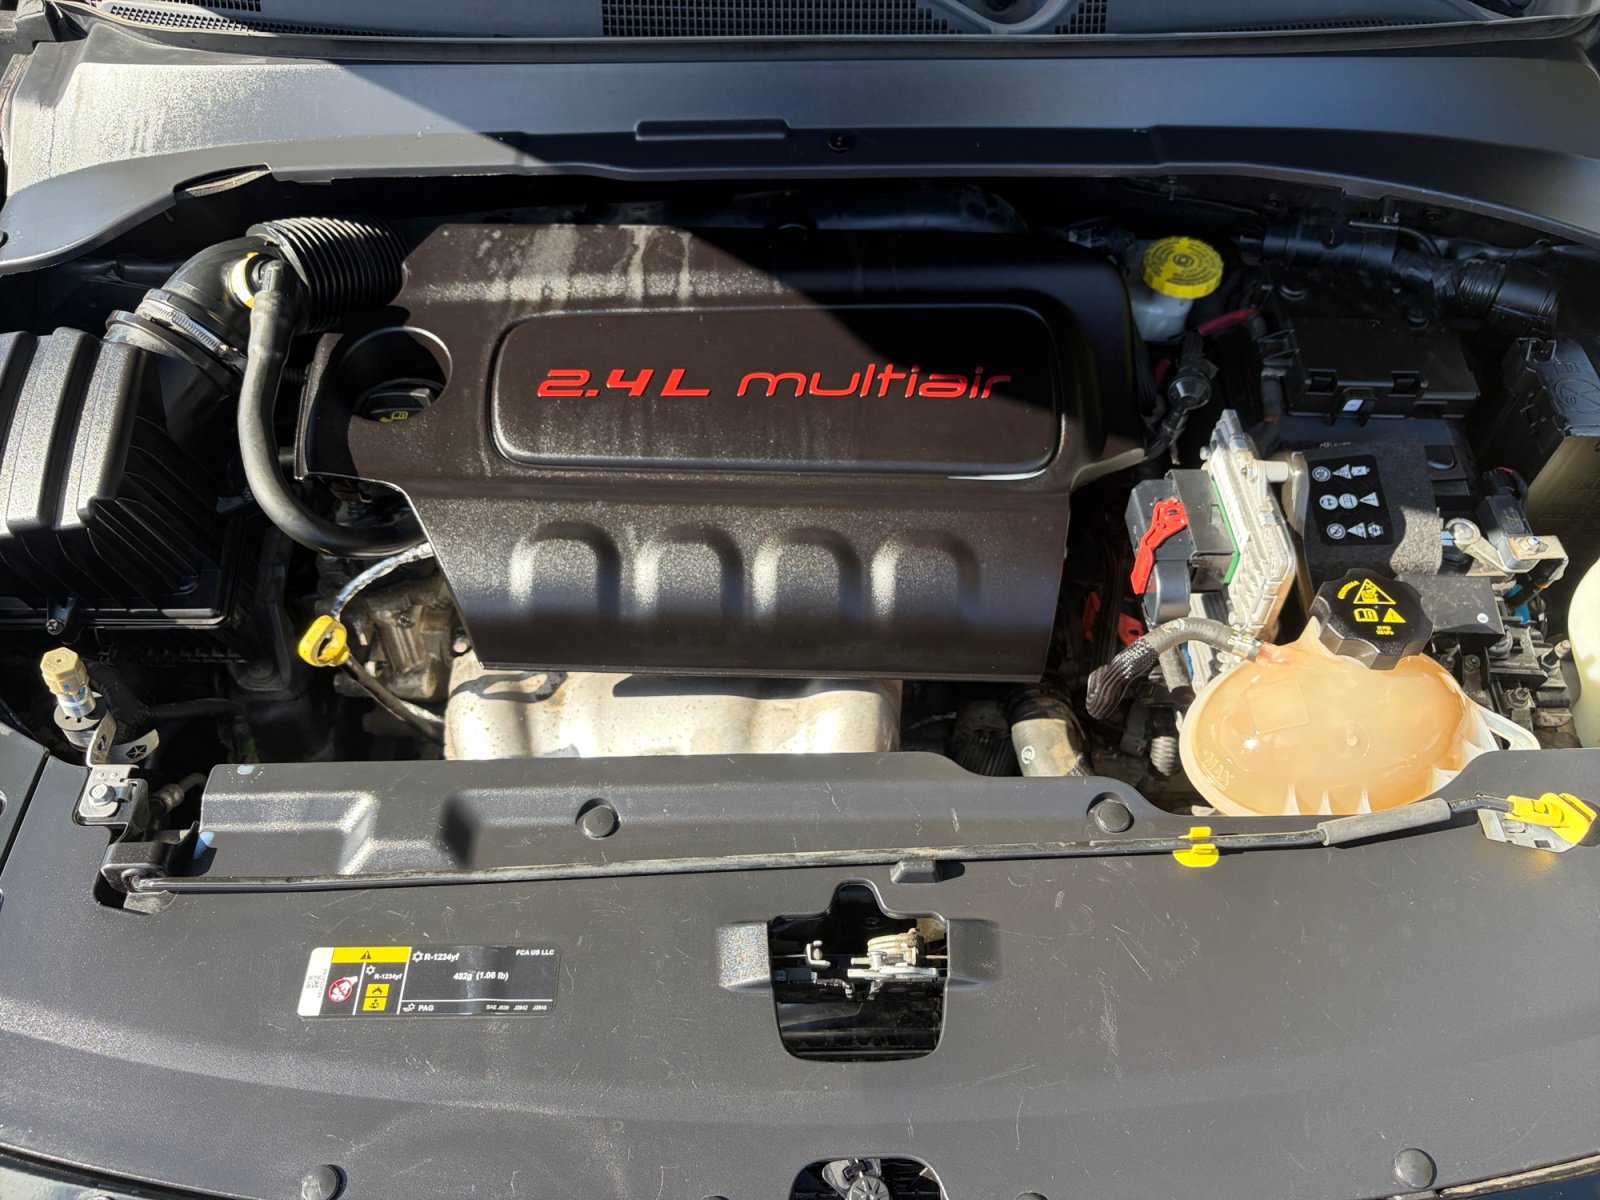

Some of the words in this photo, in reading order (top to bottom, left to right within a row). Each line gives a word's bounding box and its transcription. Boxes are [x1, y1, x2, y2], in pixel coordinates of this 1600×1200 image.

[736, 363, 1012, 398] multiair
[423, 952, 460, 962] R-1234yf
[373, 973, 403, 981] R-1234yf
[453, 972, 473, 981] 482g
[497, 971, 509, 981] lb)
[418, 1004, 434, 1012] PAG
